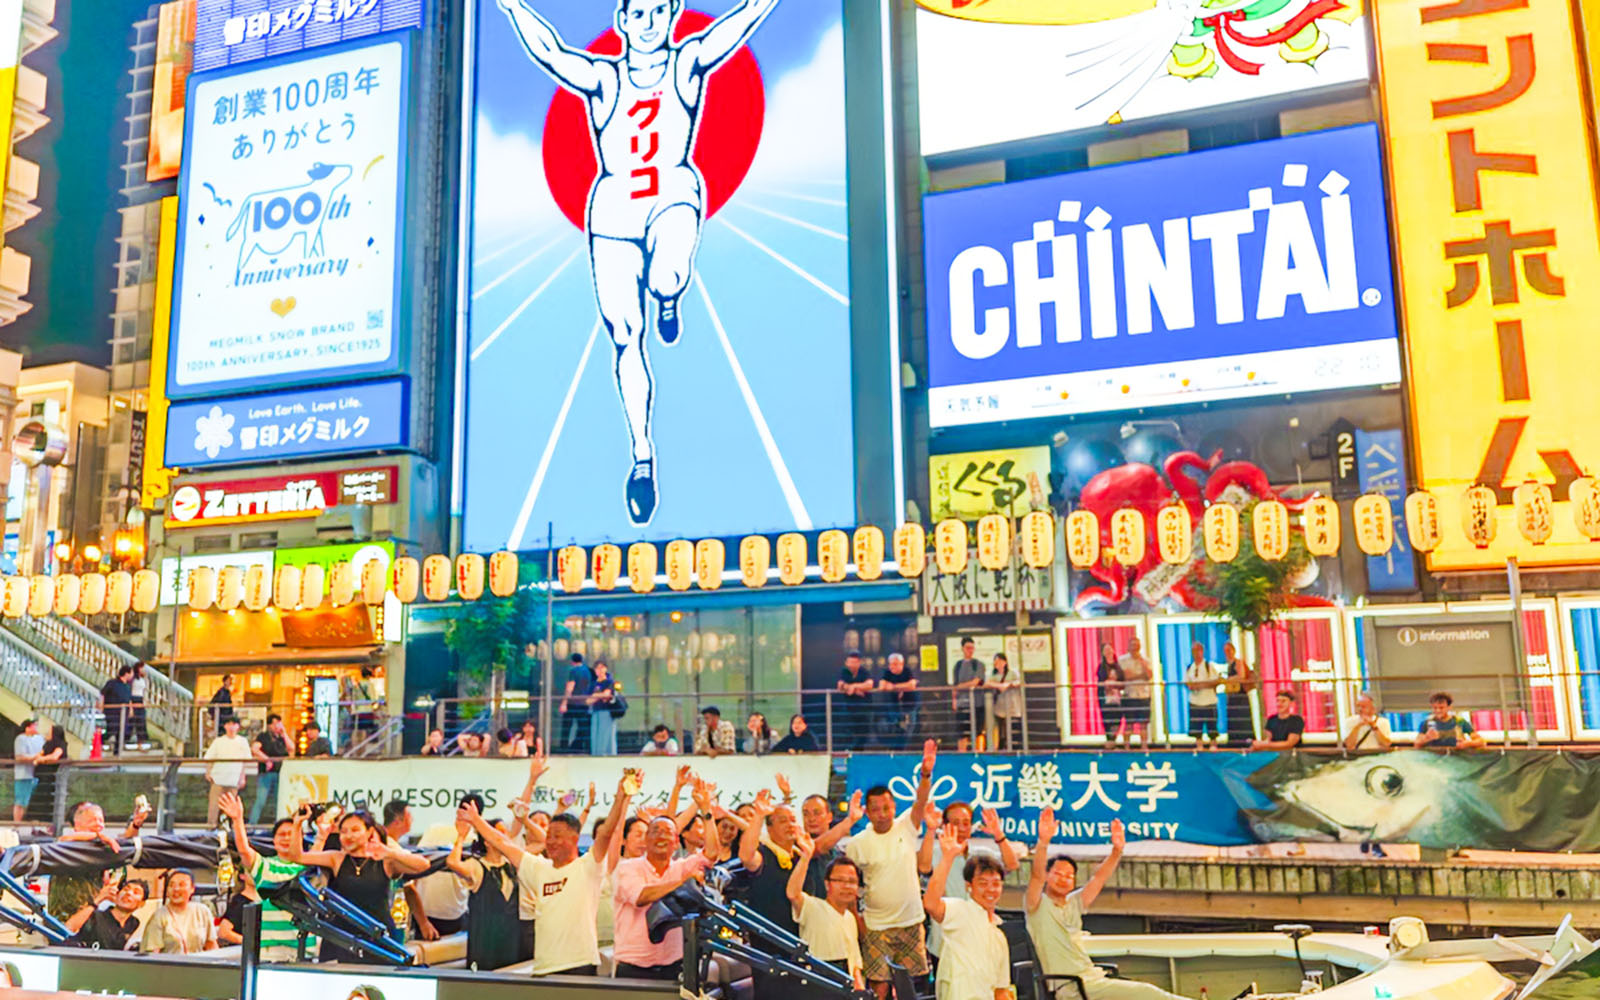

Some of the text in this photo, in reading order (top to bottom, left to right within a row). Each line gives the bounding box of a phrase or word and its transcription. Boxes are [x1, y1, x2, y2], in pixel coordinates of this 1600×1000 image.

[212, 67, 380, 125] 創業100周年
[231, 112, 356, 160] ありがとう
[627, 90, 663, 200] グリコ
[949, 164, 1359, 359] CHINTAI
[1419, 0, 1580, 505] ントホーム
[209, 321, 355, 348] MEGMILK SNOW BRAND
[240, 415, 370, 450] 雪印メグミルク
[248, 397, 362, 419] Love Earth. Love Life.
[1420, 628, 1490, 642] information
[969, 761, 1179, 812] 近畿大学
